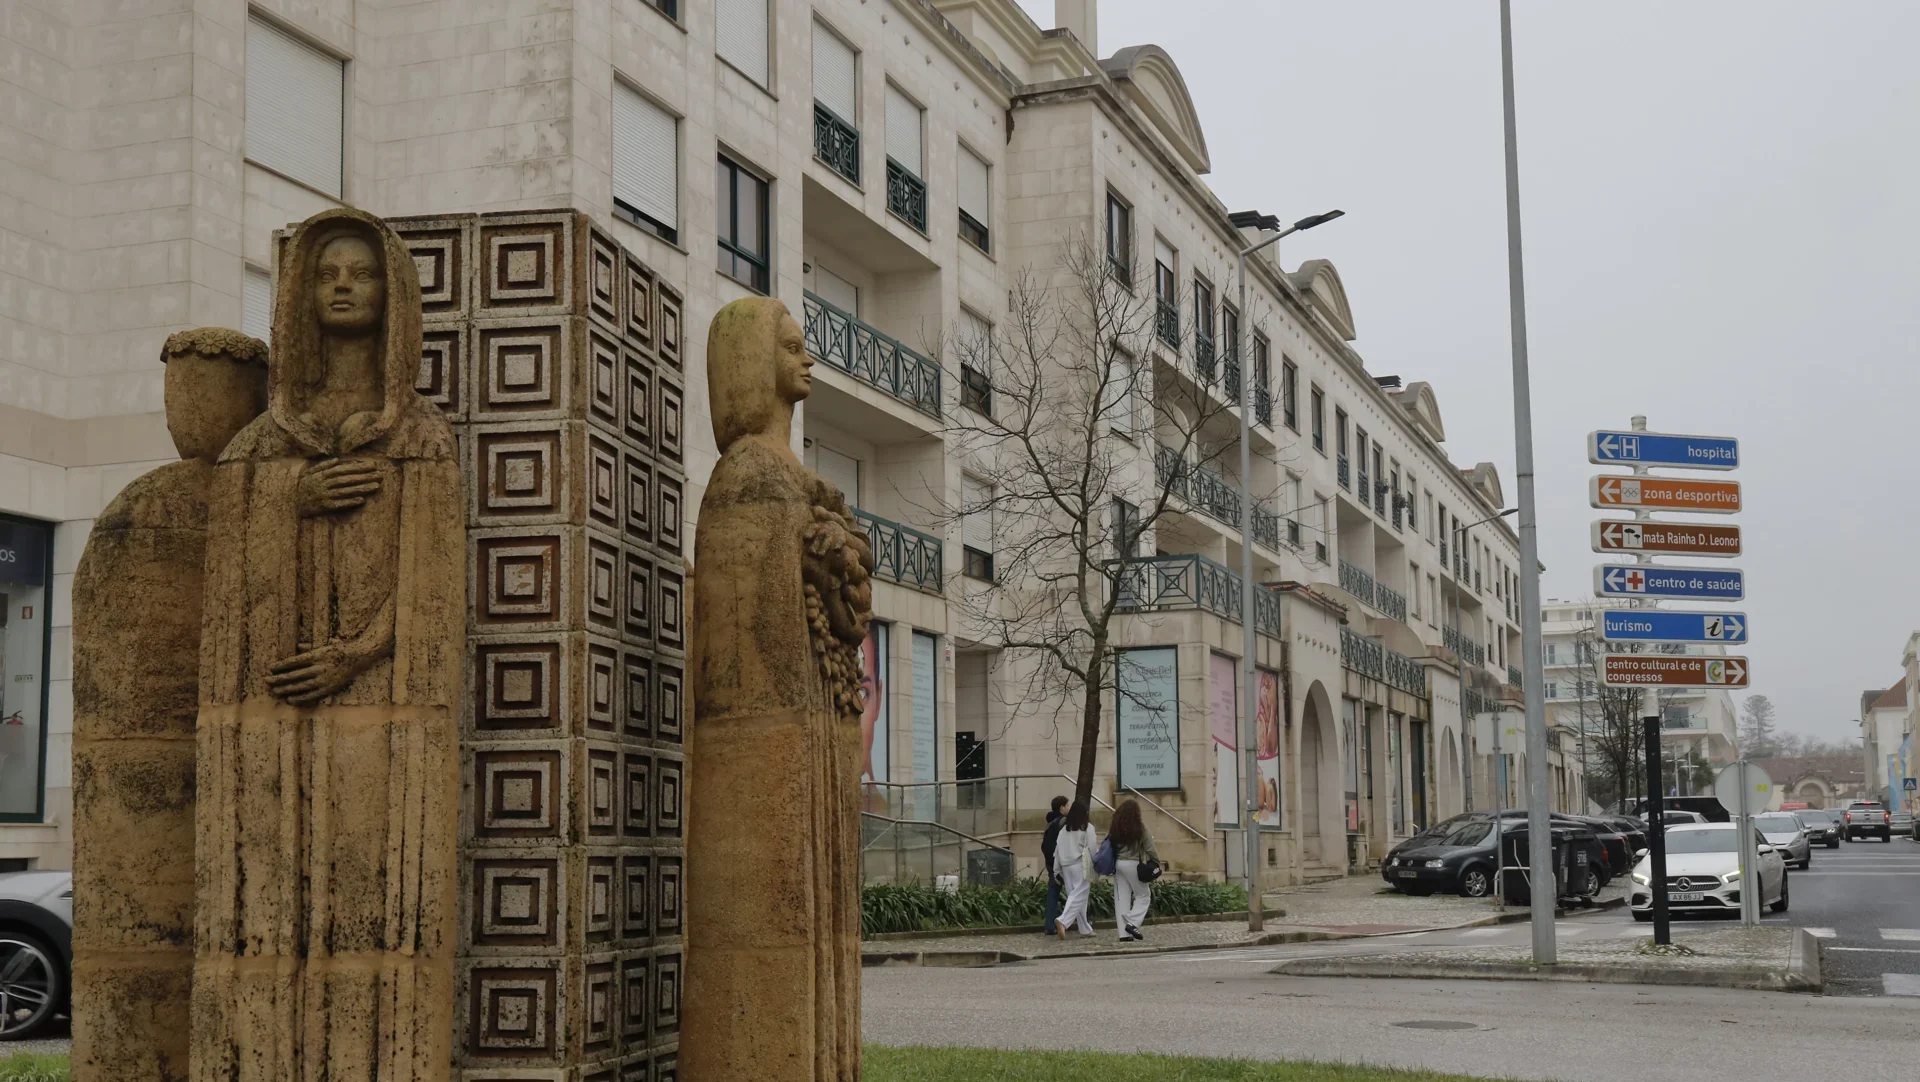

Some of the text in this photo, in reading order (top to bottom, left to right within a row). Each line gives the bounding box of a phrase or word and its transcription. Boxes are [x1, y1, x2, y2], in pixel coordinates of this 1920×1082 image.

[1688, 446, 1736, 460] hospital
[1644, 489, 1738, 504] zona desportiva
[1644, 533, 1738, 547] mata Rainha D. Leonor
[1649, 577, 1740, 591] centro de saúde
[1606, 620, 1652, 632] turismo
[1607, 660, 1638, 670] centro
[1641, 660, 1679, 670] cultural
[1689, 661, 1701, 670] de
[1607, 674, 1662, 683] congressos
